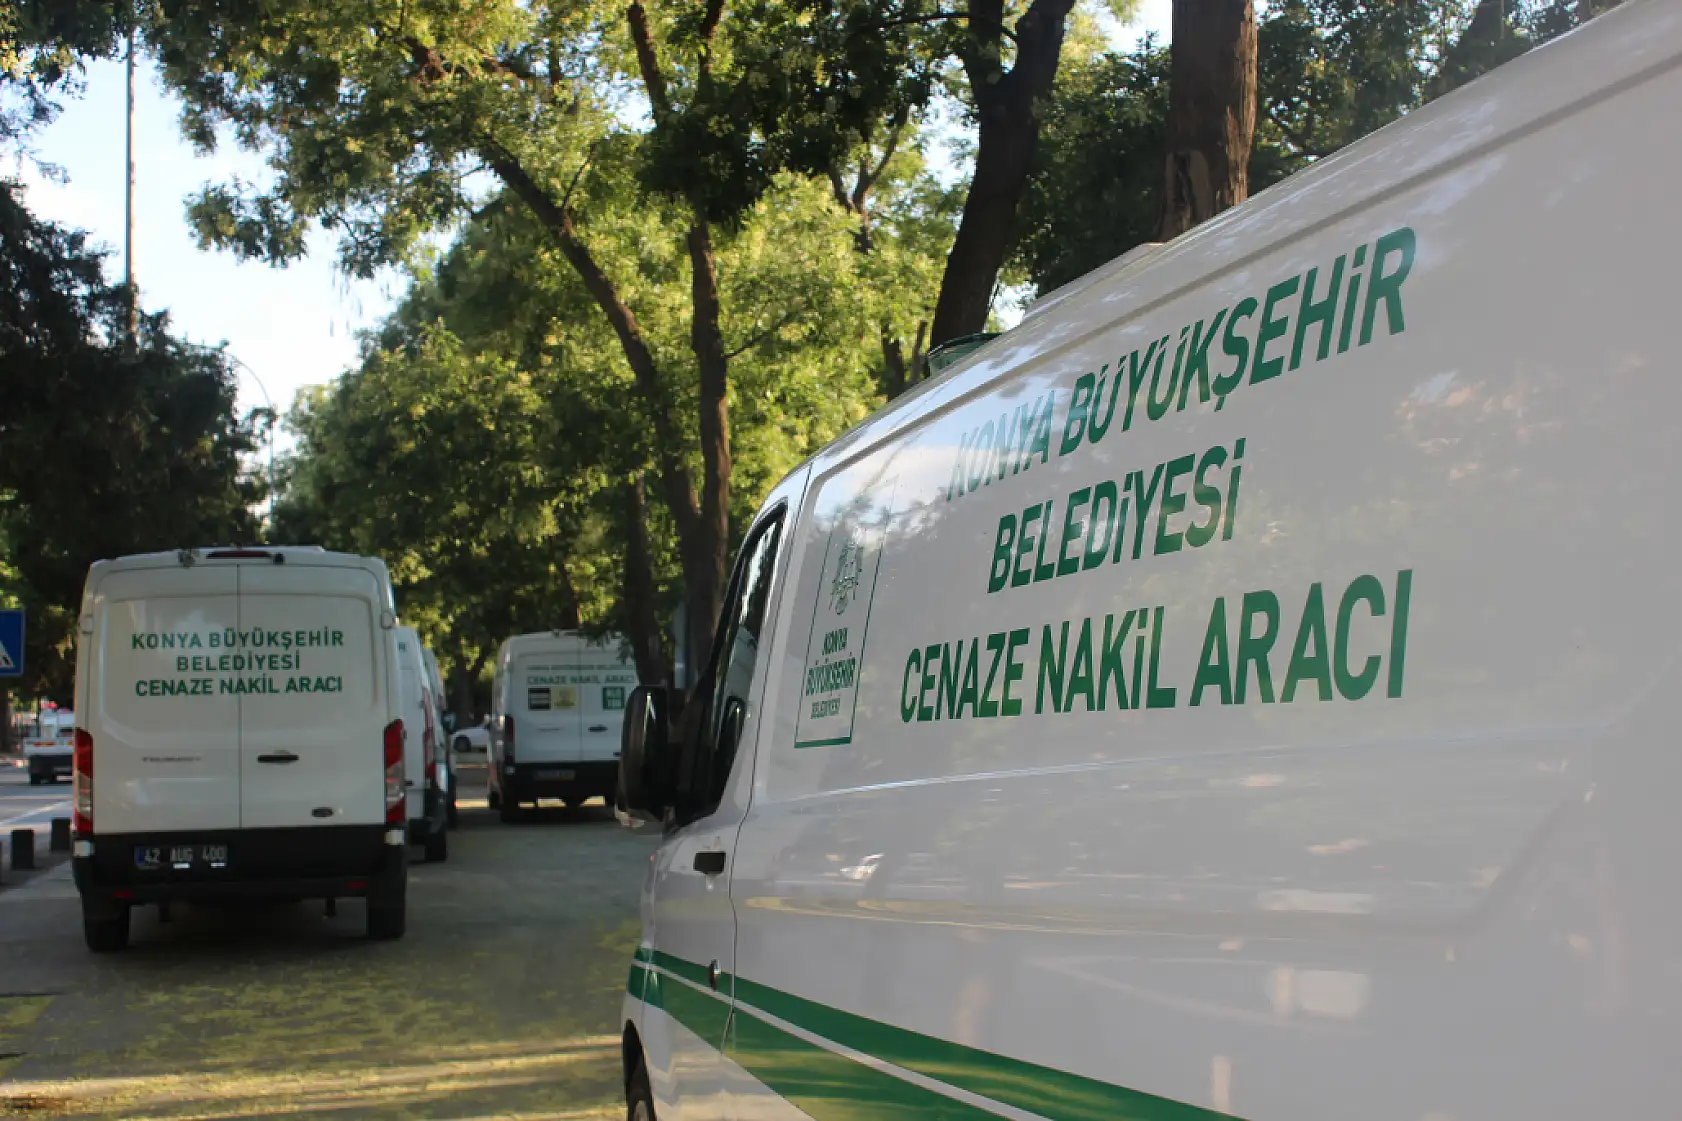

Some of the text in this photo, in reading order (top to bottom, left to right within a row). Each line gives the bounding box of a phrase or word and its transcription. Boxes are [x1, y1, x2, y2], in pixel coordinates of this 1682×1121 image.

[1058, 227, 1417, 456] BÜYÜKŞEHİR
[987, 438, 1246, 593] BELEDİYESİ
[131, 627, 344, 650] KONYA BÜYÜKŞEHİR
[176, 649, 300, 671] BELEDİYESİ
[900, 569, 1413, 723] CENAZE NAKİL ARACI
[135, 673, 343, 696] CENAZE NAKİL ARACI
